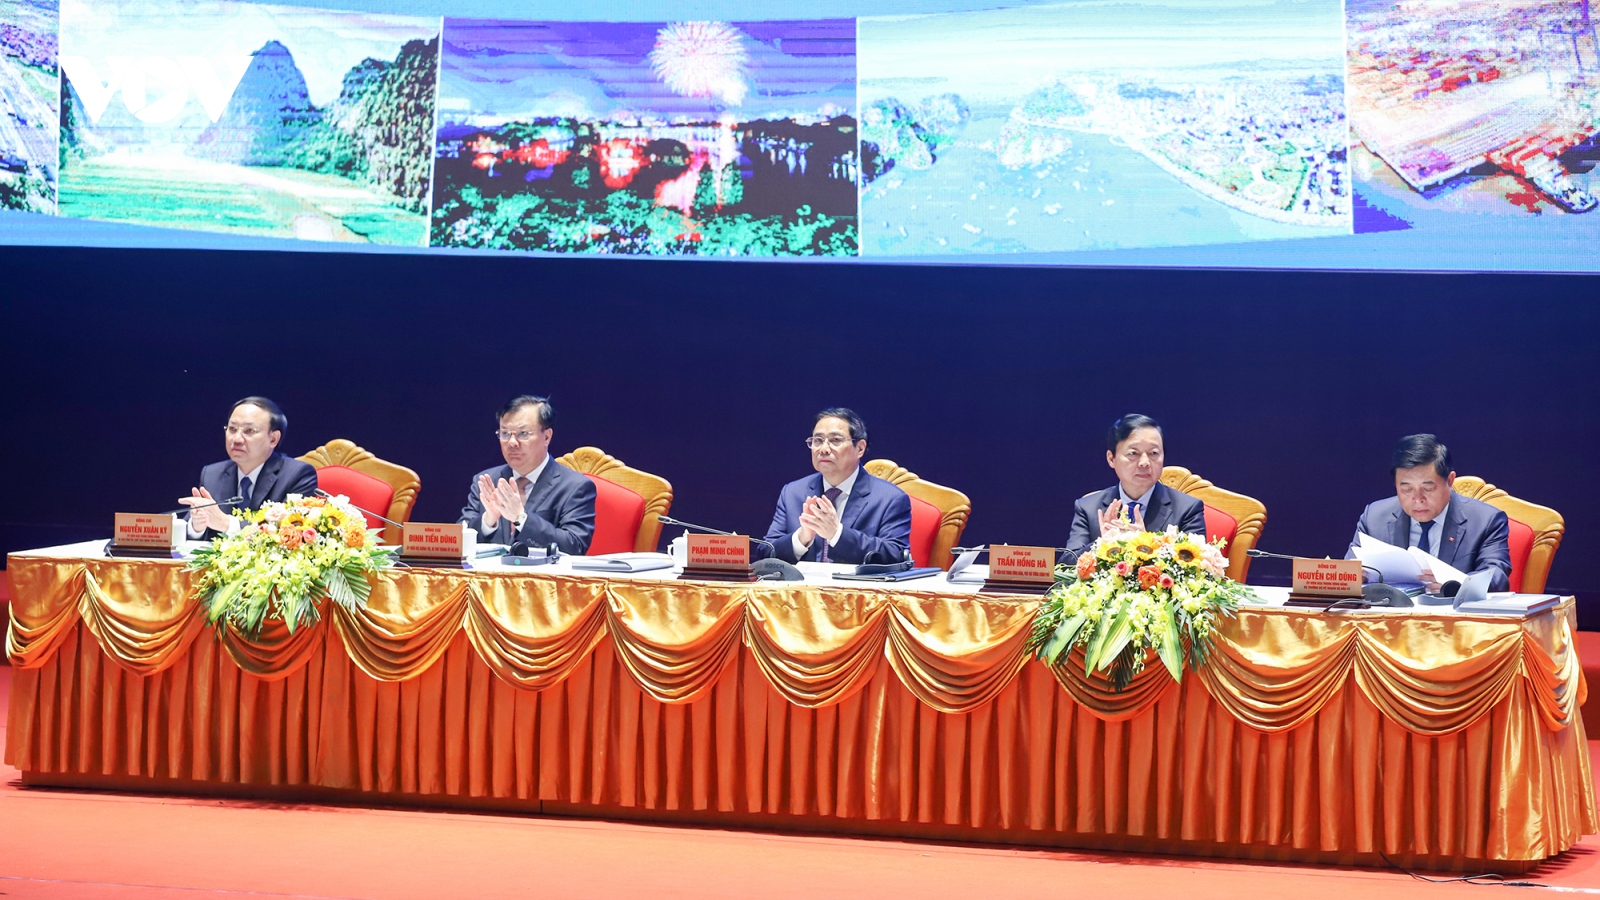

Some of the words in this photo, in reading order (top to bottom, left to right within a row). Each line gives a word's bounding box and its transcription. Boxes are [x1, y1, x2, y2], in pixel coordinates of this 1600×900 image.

[425, 533, 438, 543] TIẾN
[692, 547, 708, 556] PHẠM
[727, 546, 744, 556] CHÍNH
[1326, 572, 1337, 580] CHÍ
